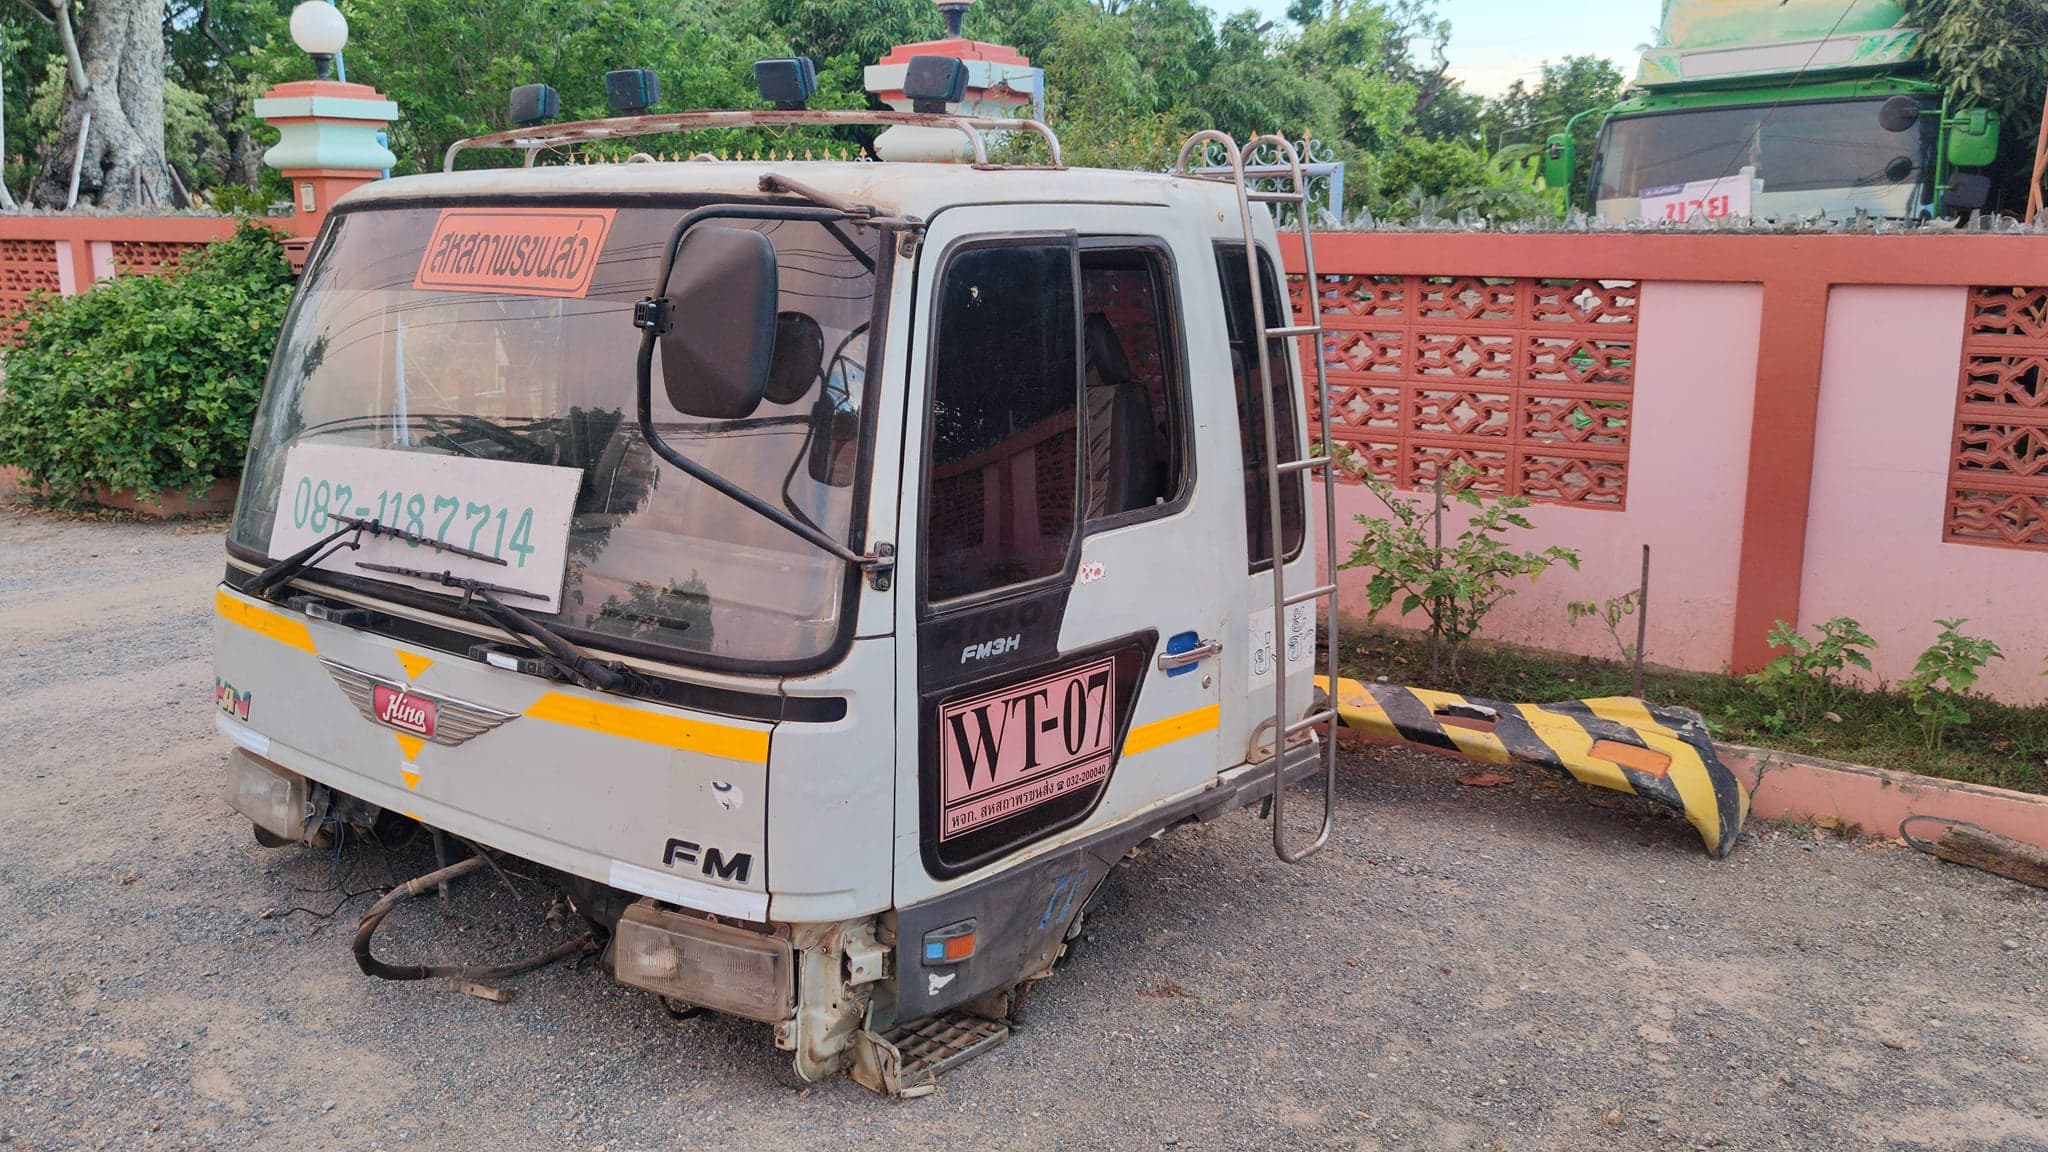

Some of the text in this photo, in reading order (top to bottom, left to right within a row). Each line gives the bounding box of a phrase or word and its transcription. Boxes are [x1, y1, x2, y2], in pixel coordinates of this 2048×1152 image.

[430, 220, 589, 280] สหสถาพรขนส่ง
[294, 476, 535, 568] 087-1187714
[960, 633, 1021, 665] FM3H
[382, 693, 427, 732] Hino
[947, 670, 1110, 791] WT-07
[980, 781, 1054, 818] สหสถาพรขนส่ง
[1066, 764, 1107, 788] 032-200040
[662, 837, 754, 885] FM
